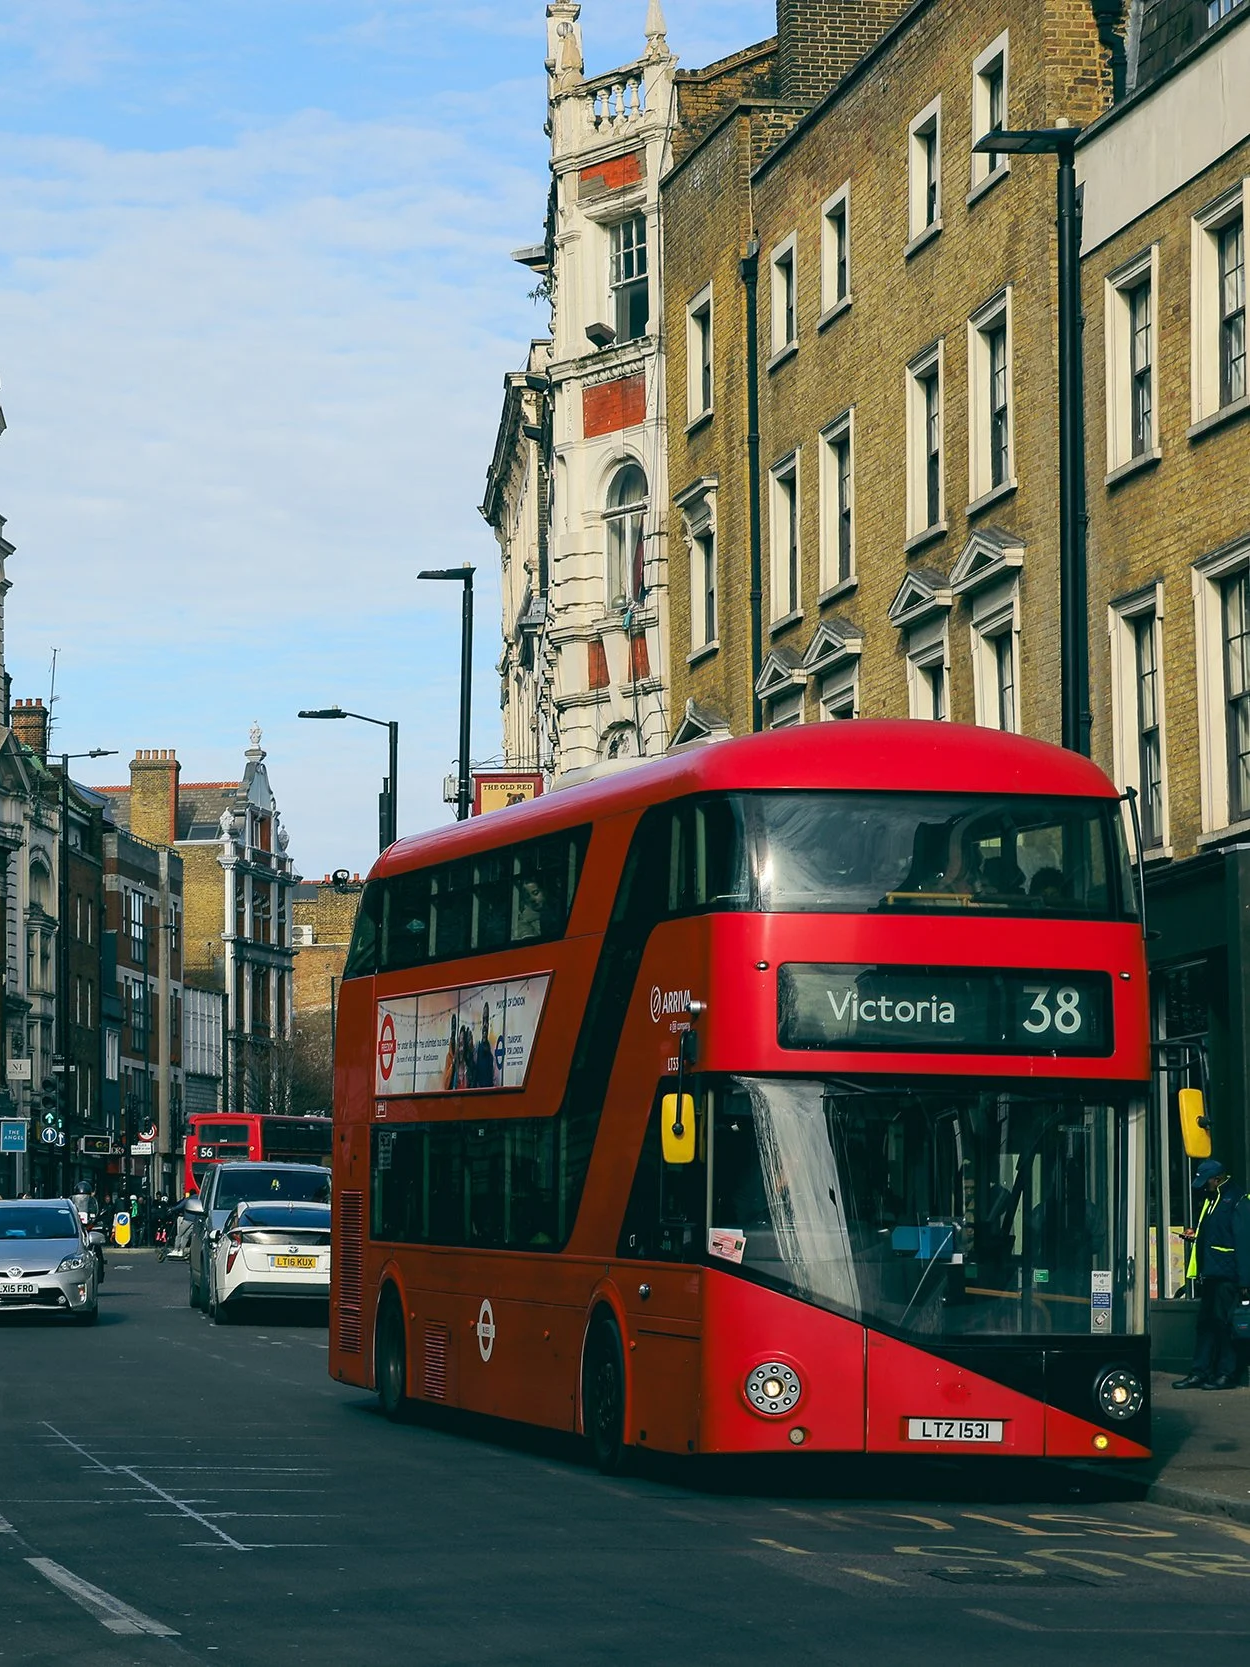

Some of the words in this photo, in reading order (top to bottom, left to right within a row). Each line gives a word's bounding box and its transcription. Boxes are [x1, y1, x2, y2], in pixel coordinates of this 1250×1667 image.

[662, 990, 691, 1014] ARRIVA
[827, 990, 955, 1023] Victoria
[1022, 985, 1082, 1034] 38
[200, 1147, 213, 1158] 56
[277, 1257, 295, 1266] LT16
[297, 1258, 313, 1266] KUX
[17, 1284, 34, 1293] FRO
[922, 1421, 955, 1438] LTZ
[959, 1422, 989, 1439] 1531
